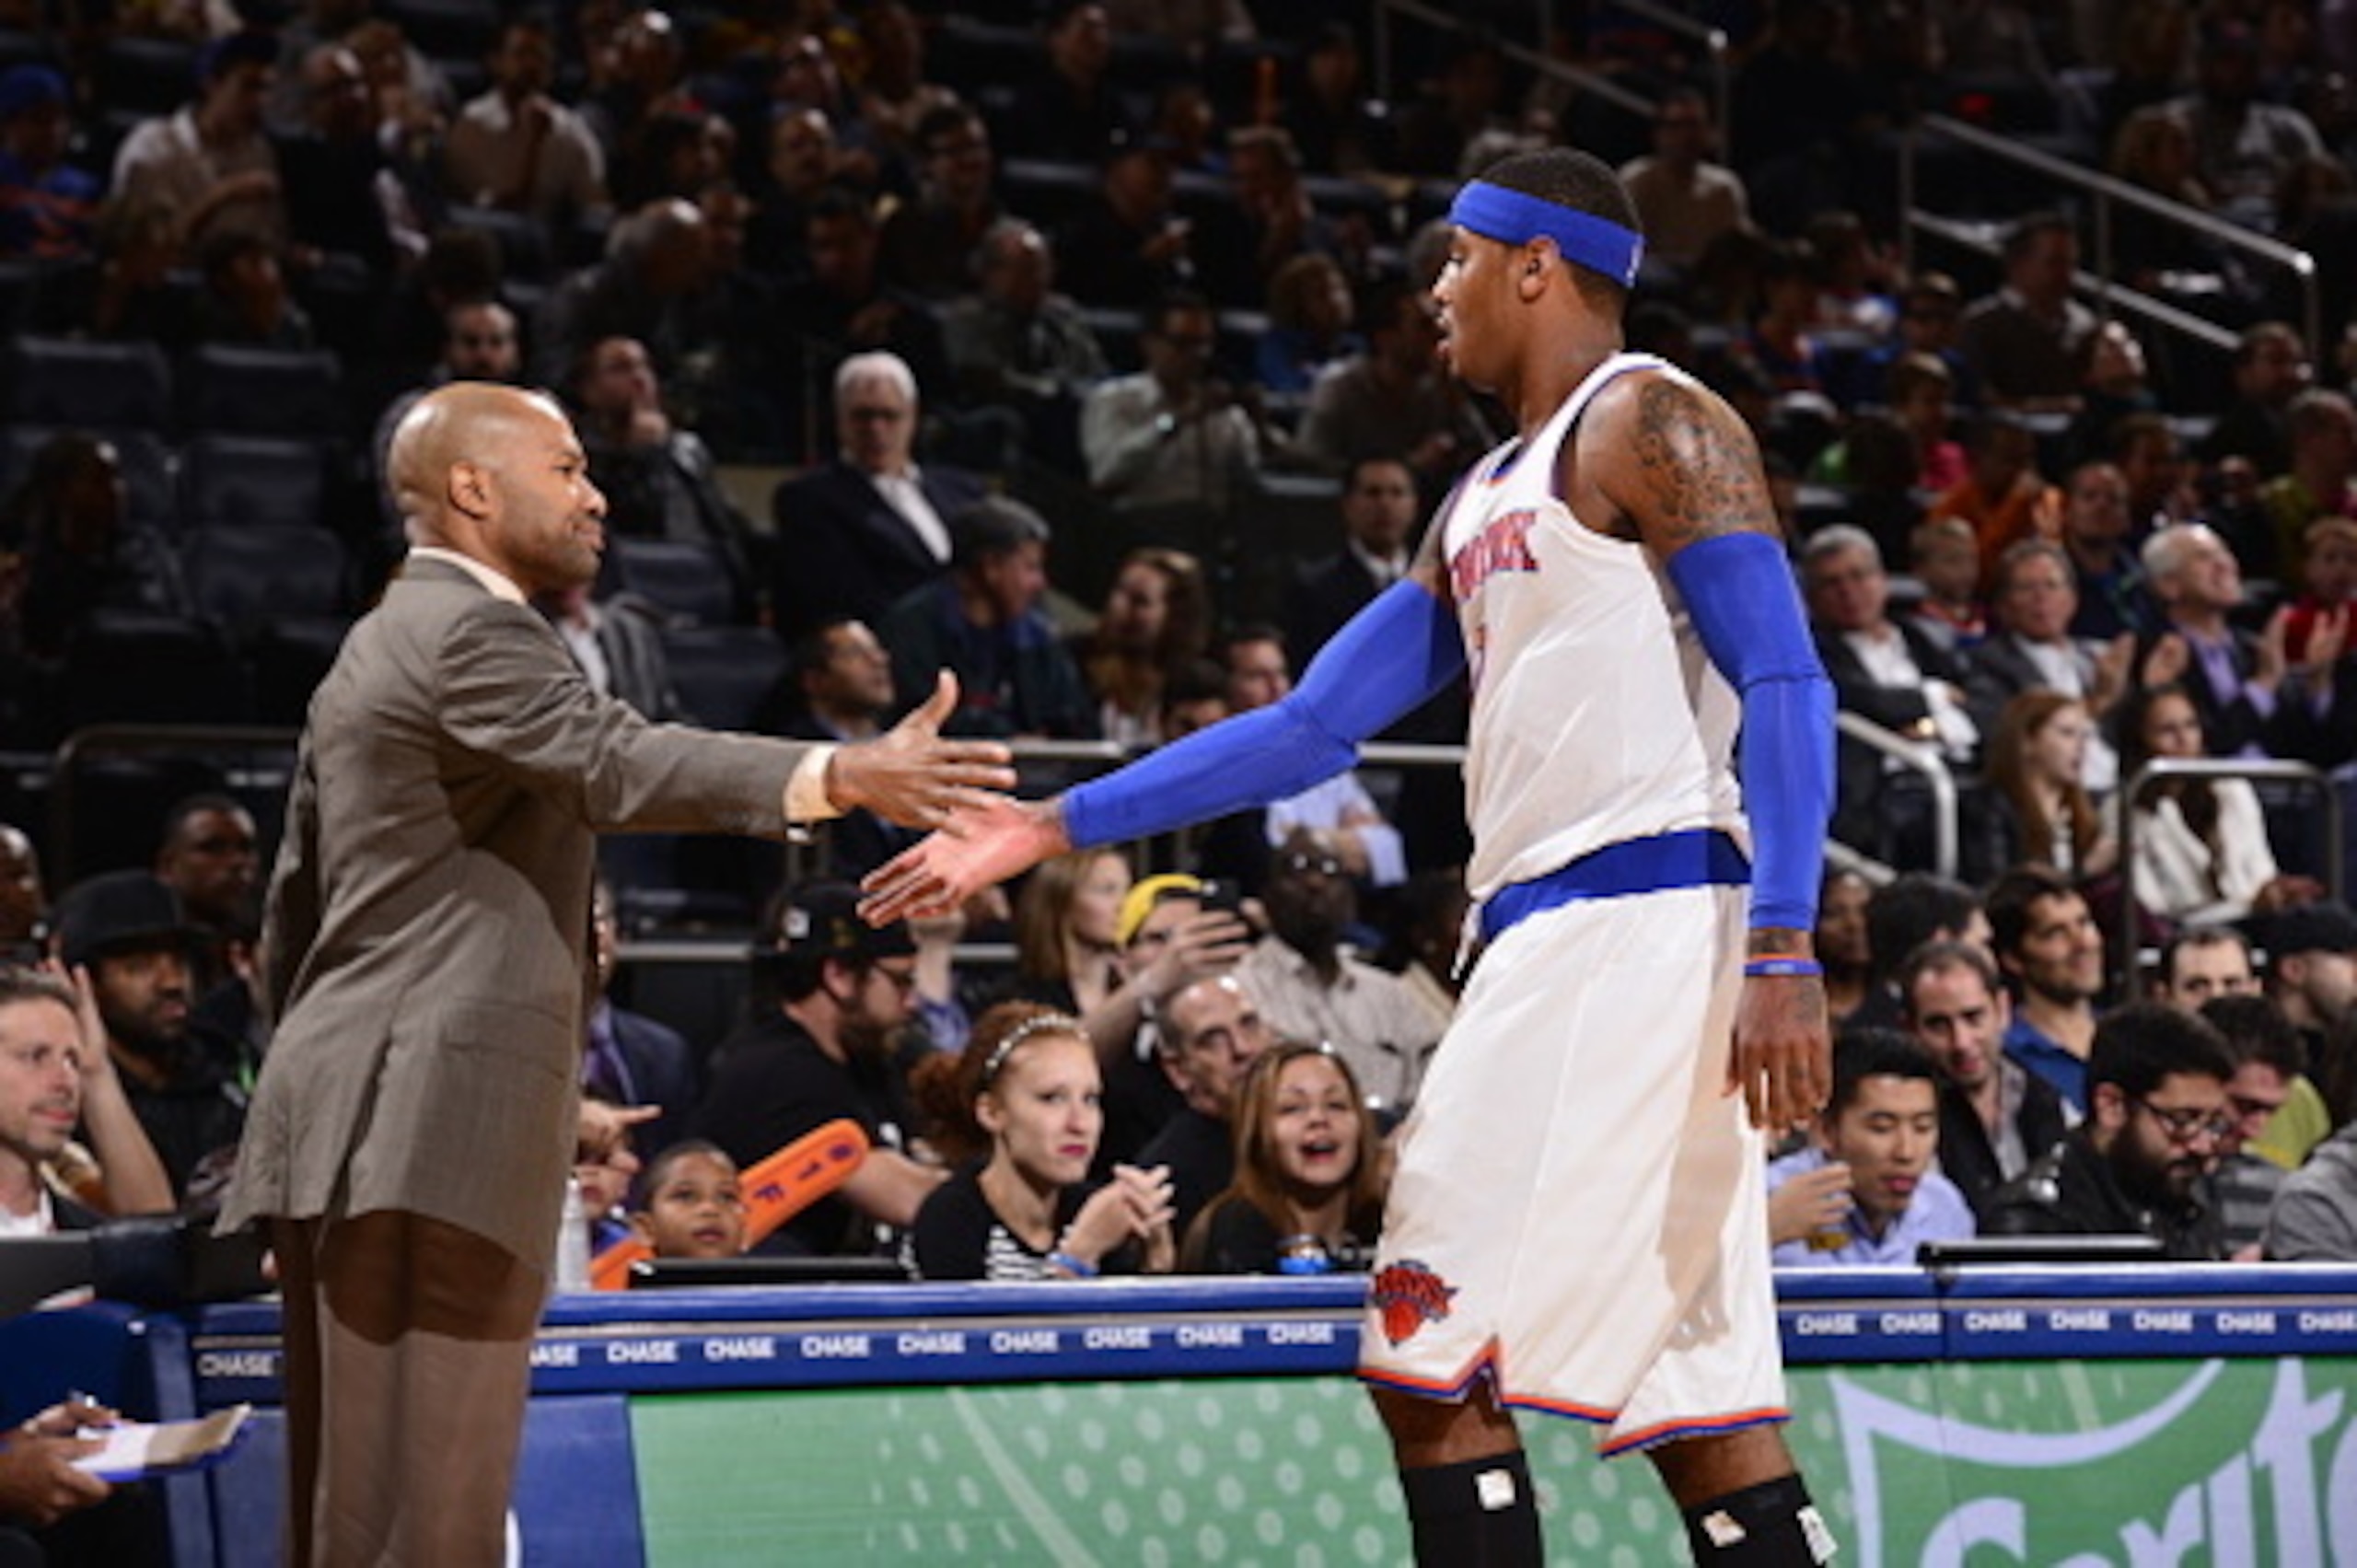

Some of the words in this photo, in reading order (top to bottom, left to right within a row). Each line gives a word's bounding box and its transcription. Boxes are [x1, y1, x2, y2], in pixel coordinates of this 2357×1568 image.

[1797, 1312, 1858, 1335] CHASE
[1880, 1313, 1939, 1334] CHASE
[1965, 1311, 2026, 1333] CHASE
[2050, 1310, 2109, 1332] CHASE
[2133, 1310, 2192, 1332] CHASE
[2217, 1311, 2275, 1334] CHASE
[2300, 1311, 2357, 1332] CHASE
[898, 1333, 966, 1355] CHASE
[991, 1331, 1058, 1354] CHASE
[1085, 1328, 1151, 1349] CHASE
[1178, 1324, 1242, 1347] CHASE
[1269, 1322, 1333, 1345] CHASE
[528, 1344, 578, 1366] ASE
[607, 1341, 678, 1363] CHASE
[704, 1338, 774, 1360] CHASE
[802, 1336, 870, 1358] CHASE
[197, 1353, 273, 1376] CHASE
